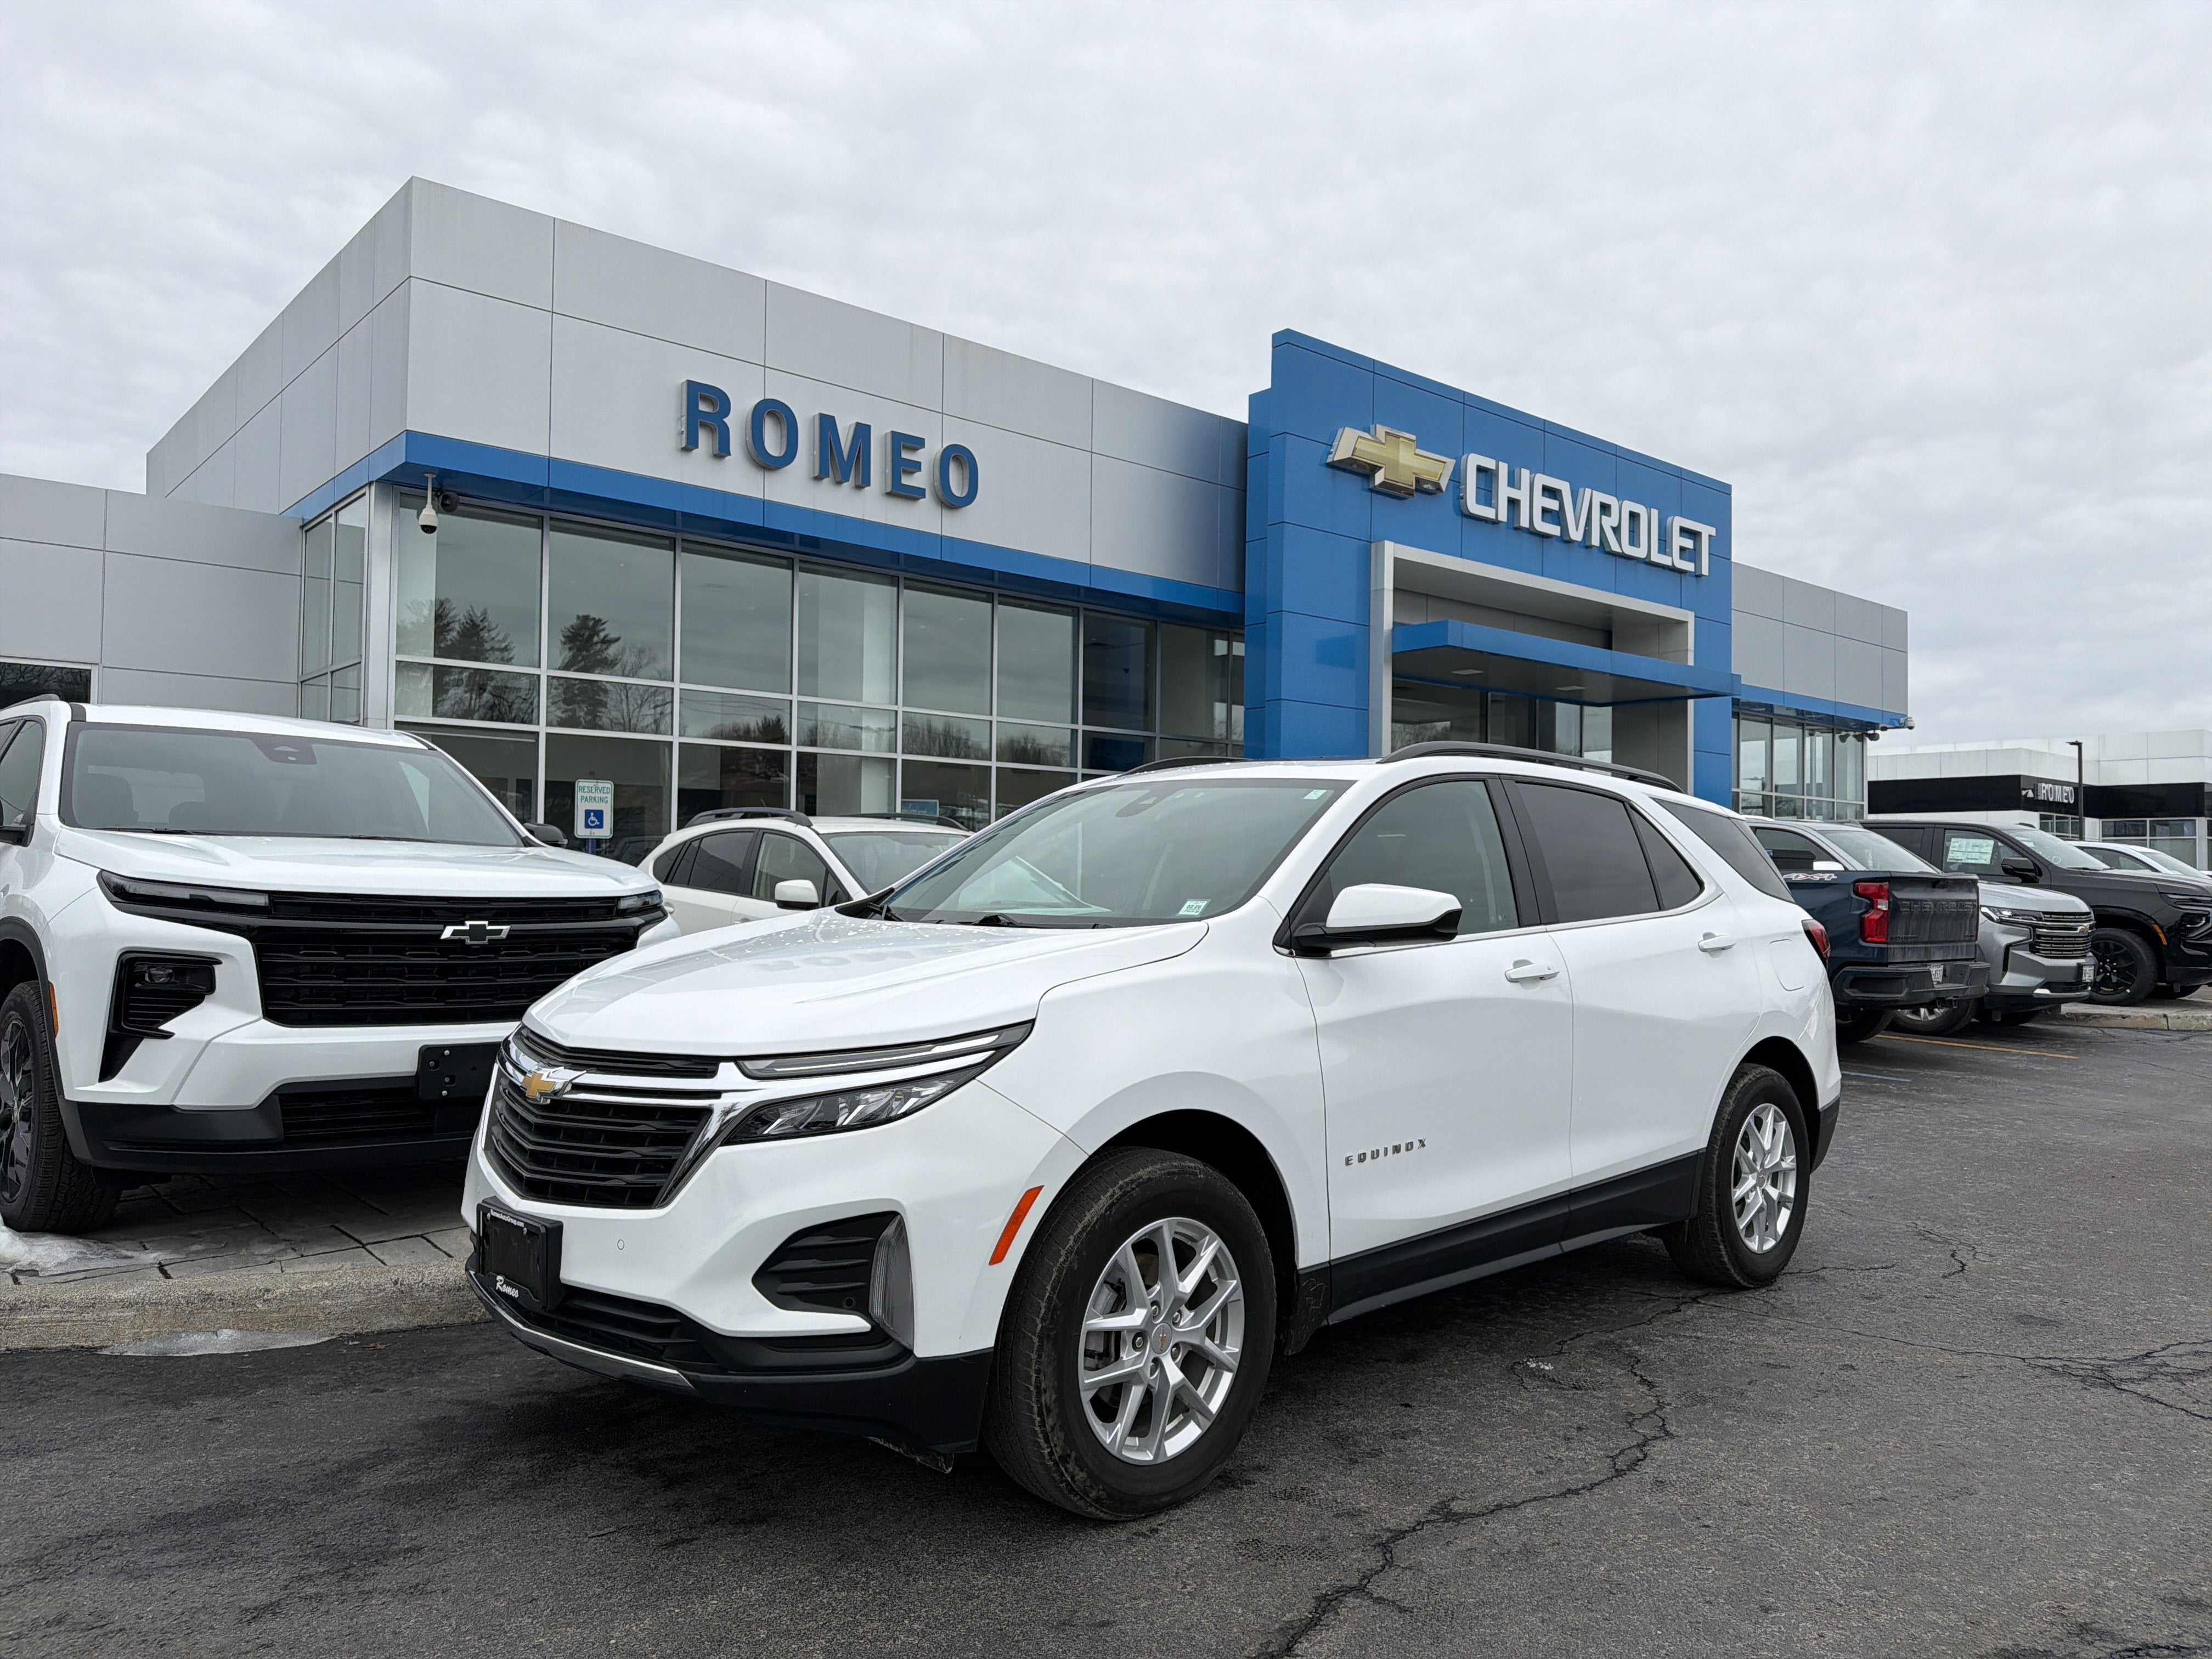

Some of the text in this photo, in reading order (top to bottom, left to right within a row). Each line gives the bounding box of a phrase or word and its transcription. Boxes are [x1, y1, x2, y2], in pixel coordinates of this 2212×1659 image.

[681, 380, 979, 509] ROMEO
[1460, 453, 1716, 576] CHEVROLET
[579, 786, 611, 794] RESERVED
[580, 795, 608, 804] PARKING
[2038, 783, 2074, 804] ROMEO
[1345, 1138, 1426, 1166] EQUINOX
[496, 1275, 519, 1298] Romeo
